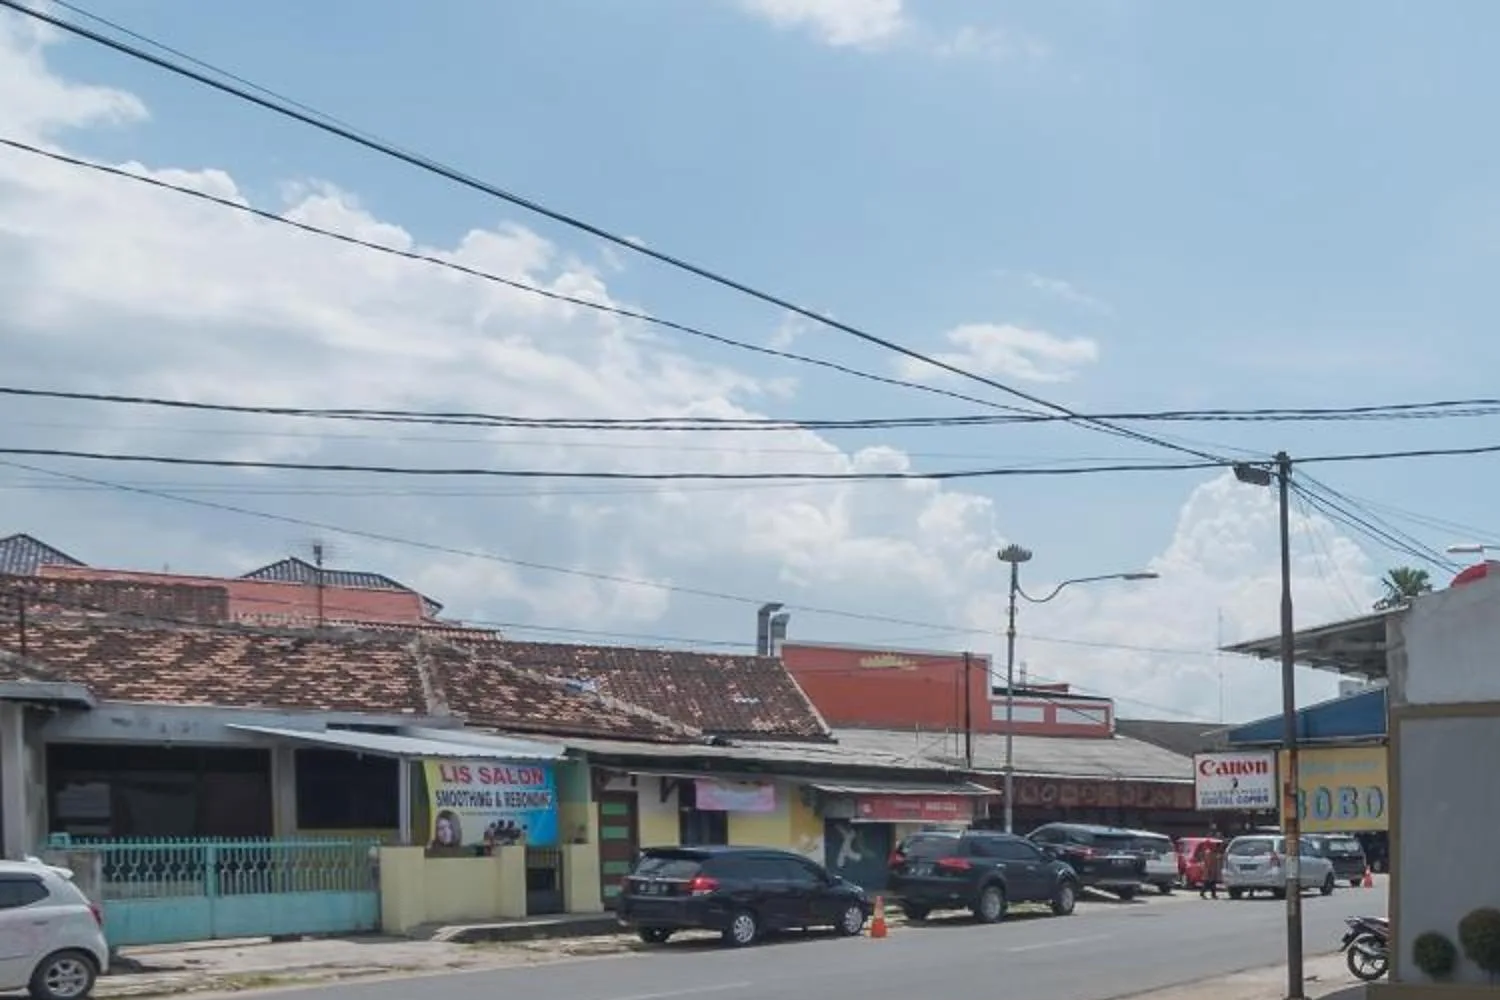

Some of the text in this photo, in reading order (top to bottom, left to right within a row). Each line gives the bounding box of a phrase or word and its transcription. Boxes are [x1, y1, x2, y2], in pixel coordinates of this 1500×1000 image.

[439, 764, 545, 786] LIS SALON
[1199, 759, 1268, 776] Canon
[436, 790, 493, 807] SMOOTHING
